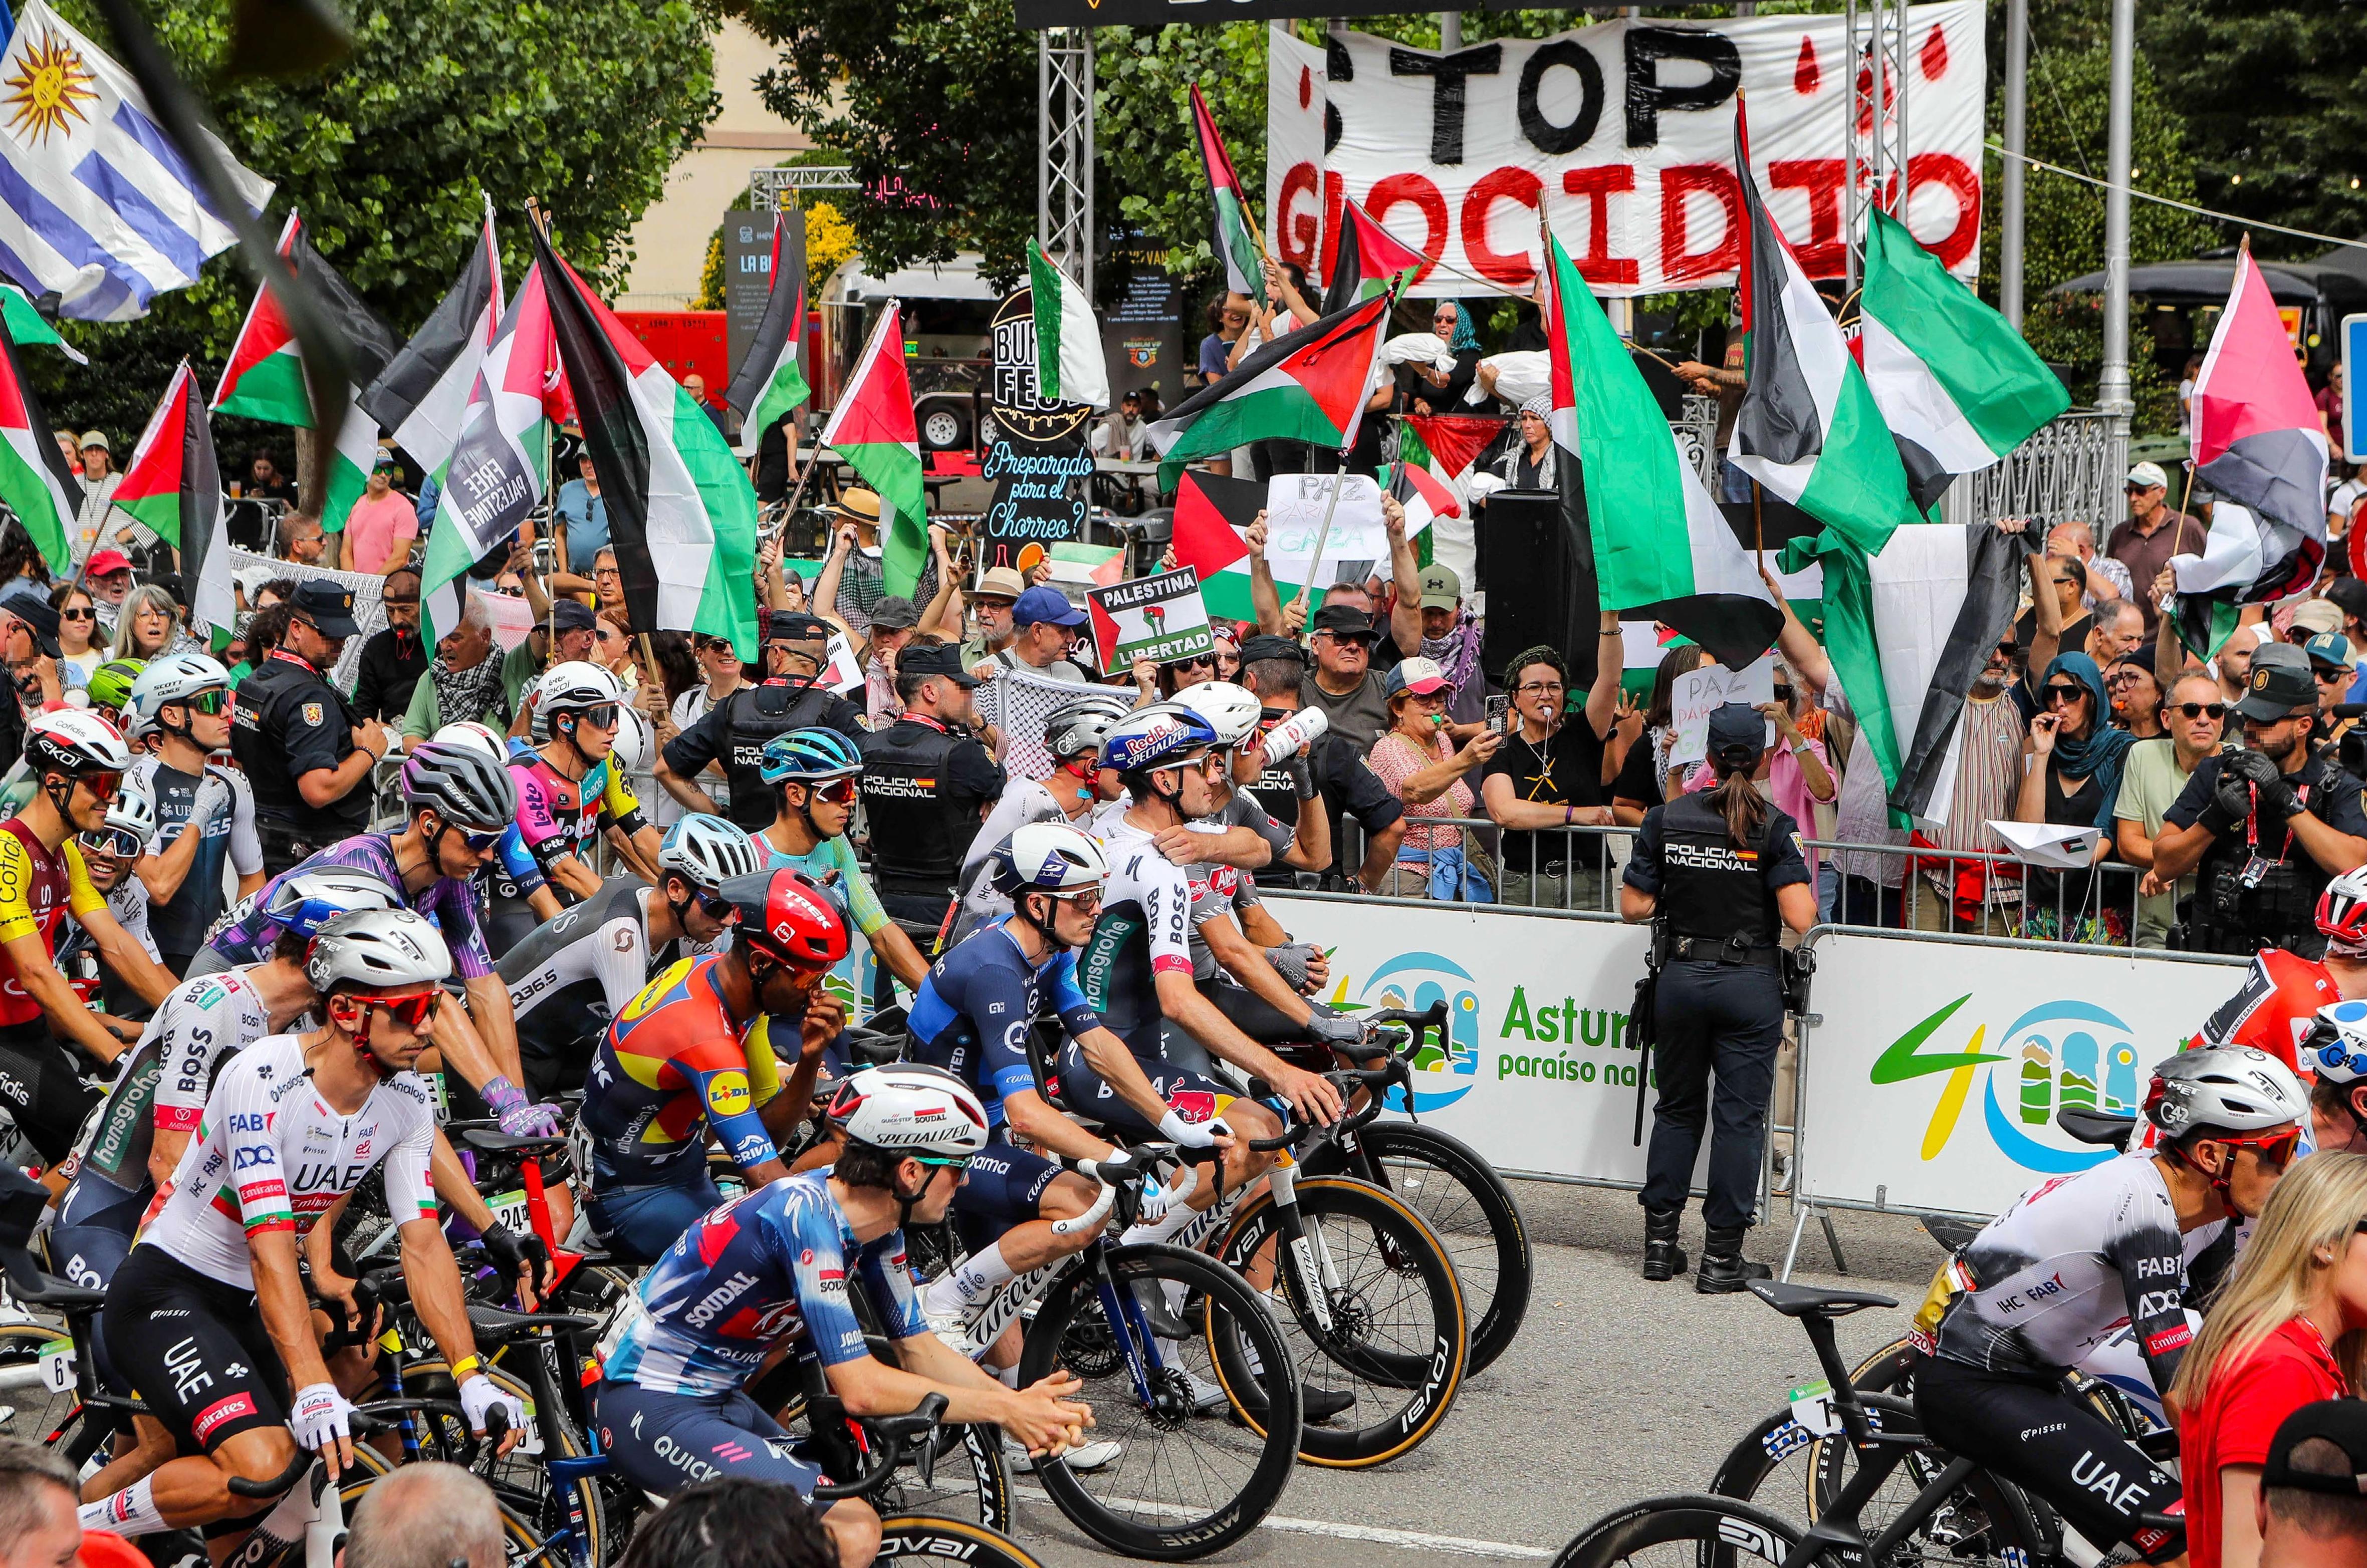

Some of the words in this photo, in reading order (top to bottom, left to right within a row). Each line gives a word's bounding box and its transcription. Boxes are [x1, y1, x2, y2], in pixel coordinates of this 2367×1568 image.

[740, 255, 756, 273] LA
[1008, 483, 1046, 505] para
[1049, 474, 1064, 499] el
[1104, 574, 1196, 607] PALESTINA
[153, 679, 184, 690] SCOTT
[56, 720, 87, 737] Cofidis
[1127, 725, 1190, 769] SPECIALIZED
[863, 775, 919, 788] POLICIA
[1261, 770, 1292, 780] ICIA
[443, 782, 478, 812] GIANT
[864, 786, 936, 798] NACIONAL
[542, 837, 566, 852] Lotto
[1665, 843, 1739, 860] POLICIA
[676, 852, 705, 876] SCOTT
[1666, 854, 1758, 872] NACIONAL
[785, 889, 833, 930] TREK
[1169, 883, 1187, 946] BOSS
[318, 937, 345, 952] MET
[388, 930, 426, 962] MET
[309, 957, 332, 979] G42
[2230, 997, 2262, 1033] VINGEGAARD
[177, 1026, 212, 1092] BOSS
[1498, 1051, 1597, 1084] paraíso
[2326, 1047, 2359, 1069] G42
[388, 1078, 425, 1104] Analog
[1097, 1077, 1164, 1099] BA
[2167, 1080, 2201, 1096] MET
[2248, 1070, 2286, 1103] MET
[93, 1068, 160, 1165] hansgrohe
[915, 1115, 947, 1124] SOUDAL
[2160, 1101, 2189, 1125] G42
[616, 1110, 650, 1155] unbroken
[876, 1123, 970, 1144] SPECIALIZED
[733, 1141, 776, 1165] CRIVIT
[188, 1178, 207, 1199] IHC
[292, 1164, 365, 1191] UAE
[241, 1182, 284, 1201] Emirates
[1228, 1216, 1267, 1267] val
[1299, 1237, 1327, 1315] SPECIALIZED
[685, 1271, 761, 1329] SOUDAL
[1996, 1295, 2025, 1315] IHC
[2150, 1329, 2192, 1351] Emirates
[55, 1358, 64, 1386] 6
[162, 1336, 214, 1405] UAE
[1402, 1335, 1450, 1434] roval
[302, 1398, 332, 1408] UAE
[2032, 1422, 2066, 1437] PISSEI
[654, 1435, 724, 1483] QUICK
[1818, 1436, 1834, 1480] RESE
[2071, 1450, 2150, 1515] UAE
[1842, 1549, 1861, 1562] UAE
